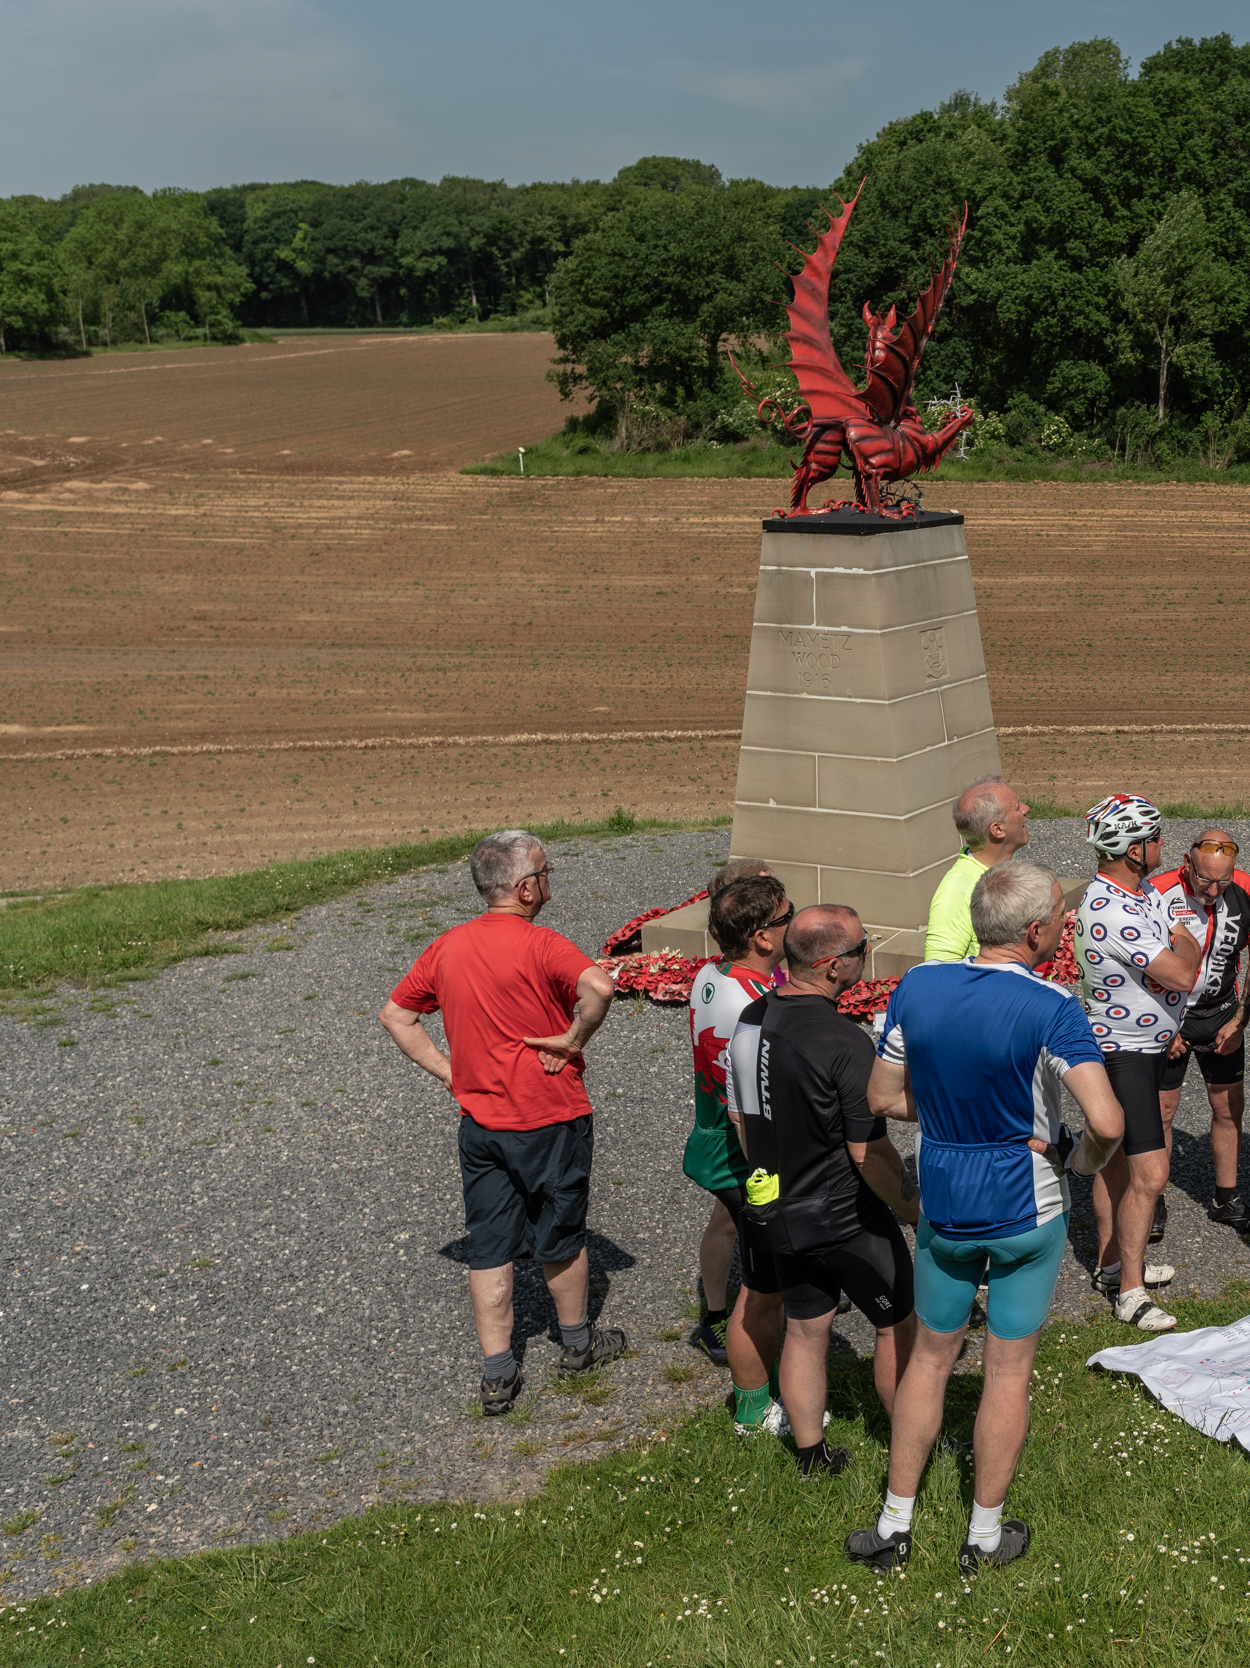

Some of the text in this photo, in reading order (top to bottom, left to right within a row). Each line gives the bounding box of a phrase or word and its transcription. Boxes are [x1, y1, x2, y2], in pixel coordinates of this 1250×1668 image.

[779, 630, 852, 651] MAMETZ
[792, 651, 841, 669] WOOD
[798, 671, 831, 689] 1916
[1114, 820, 1138, 830] KASK
